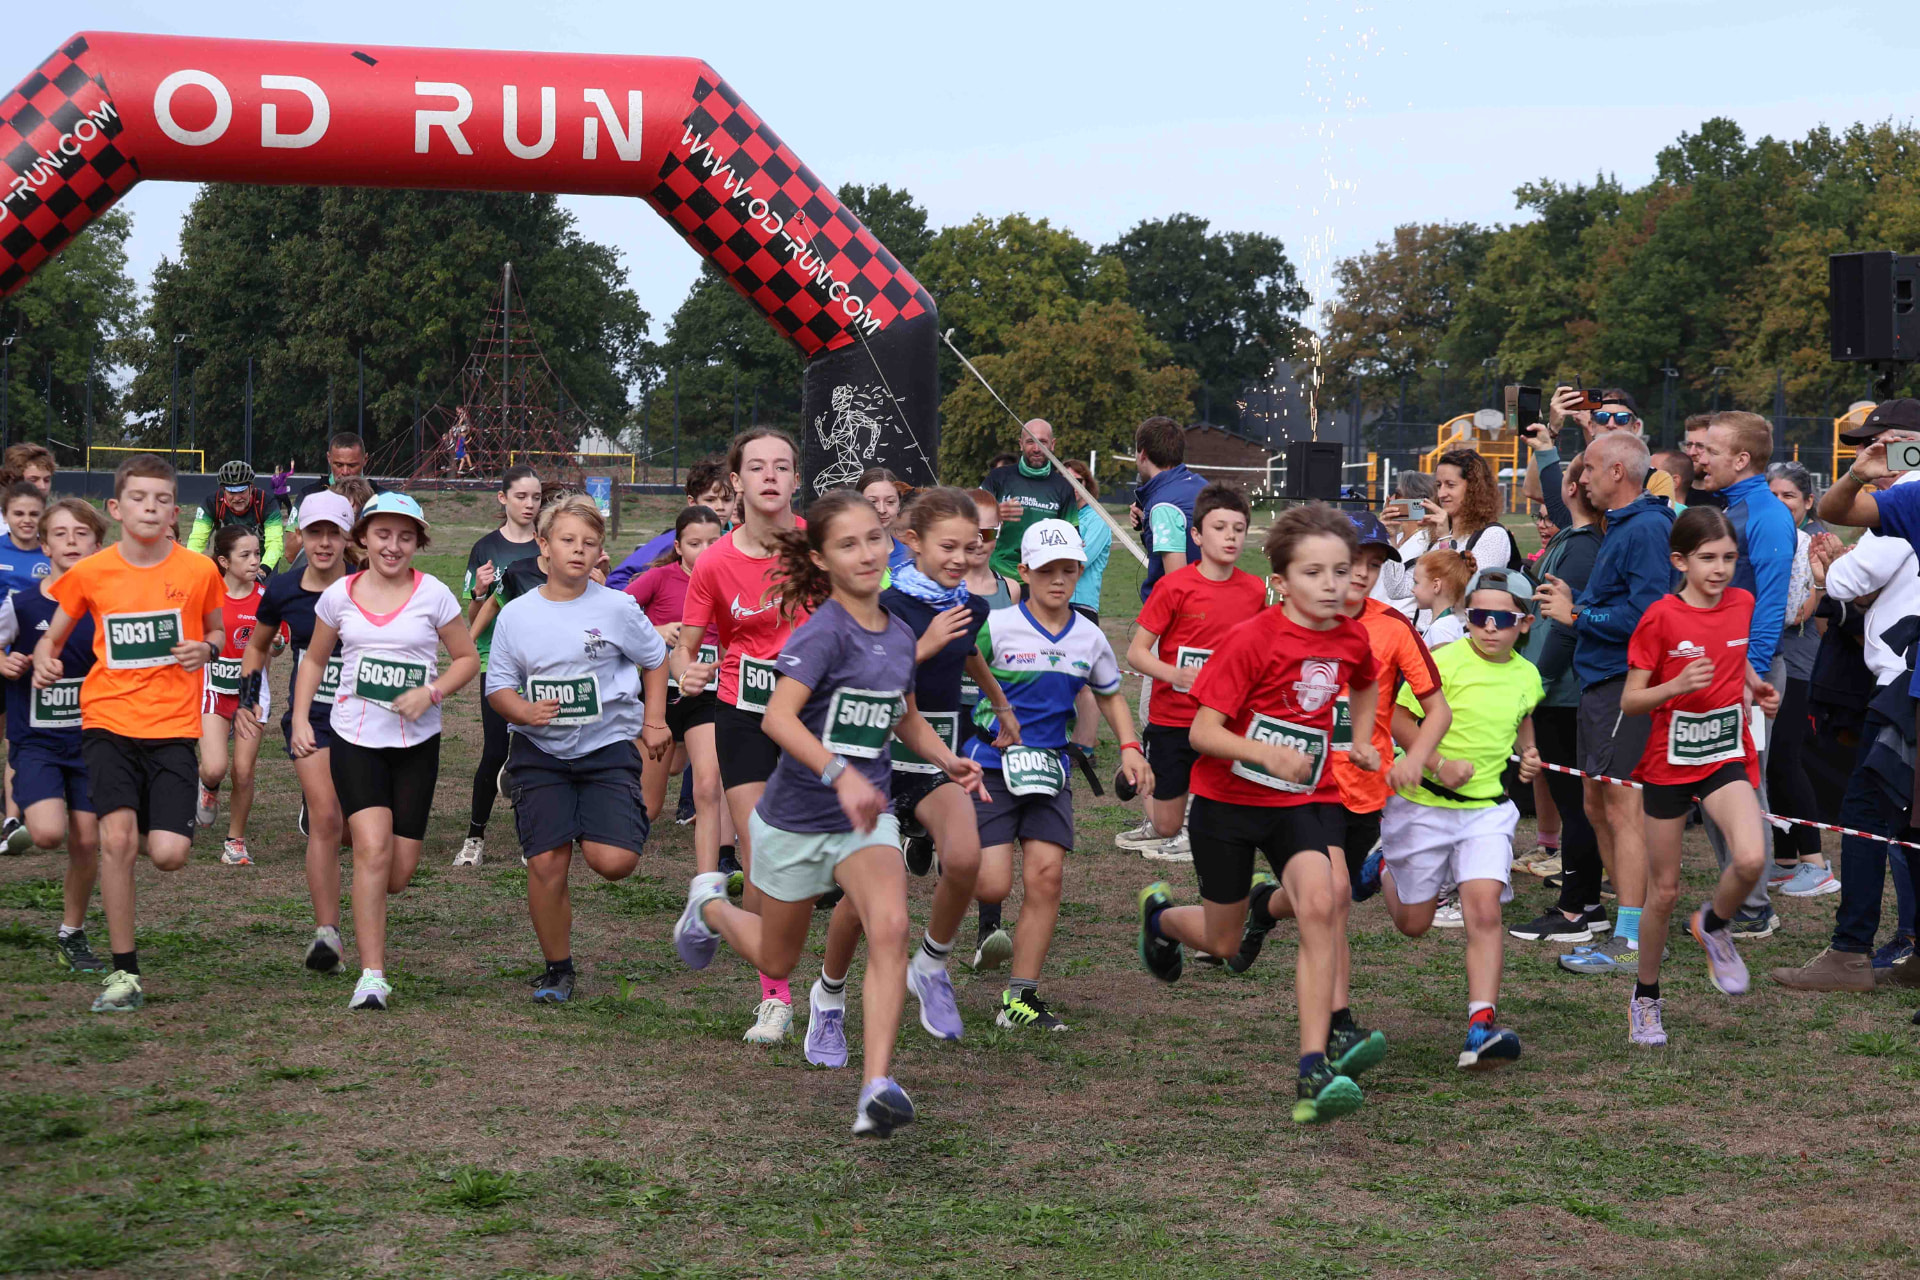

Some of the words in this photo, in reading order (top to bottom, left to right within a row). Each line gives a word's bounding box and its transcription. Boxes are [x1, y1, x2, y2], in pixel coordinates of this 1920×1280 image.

[154, 69, 331, 149] OD
[414, 81, 643, 162] RUN
[681, 124, 883, 336] WWW.OD-RUN.COM
[1040, 529, 1068, 547] LA
[112, 620, 156, 645] 5031
[211, 662, 242, 680] 5022
[320, 665, 339, 685] 12
[359, 660, 407, 689] 5030
[746, 665, 777, 692] 501
[41, 686, 79, 706] 5011
[534, 684, 576, 705] 5010
[838, 699, 893, 730] 5016
[1675, 718, 1722, 743] 5009
[1008, 751, 1050, 774] 5005
